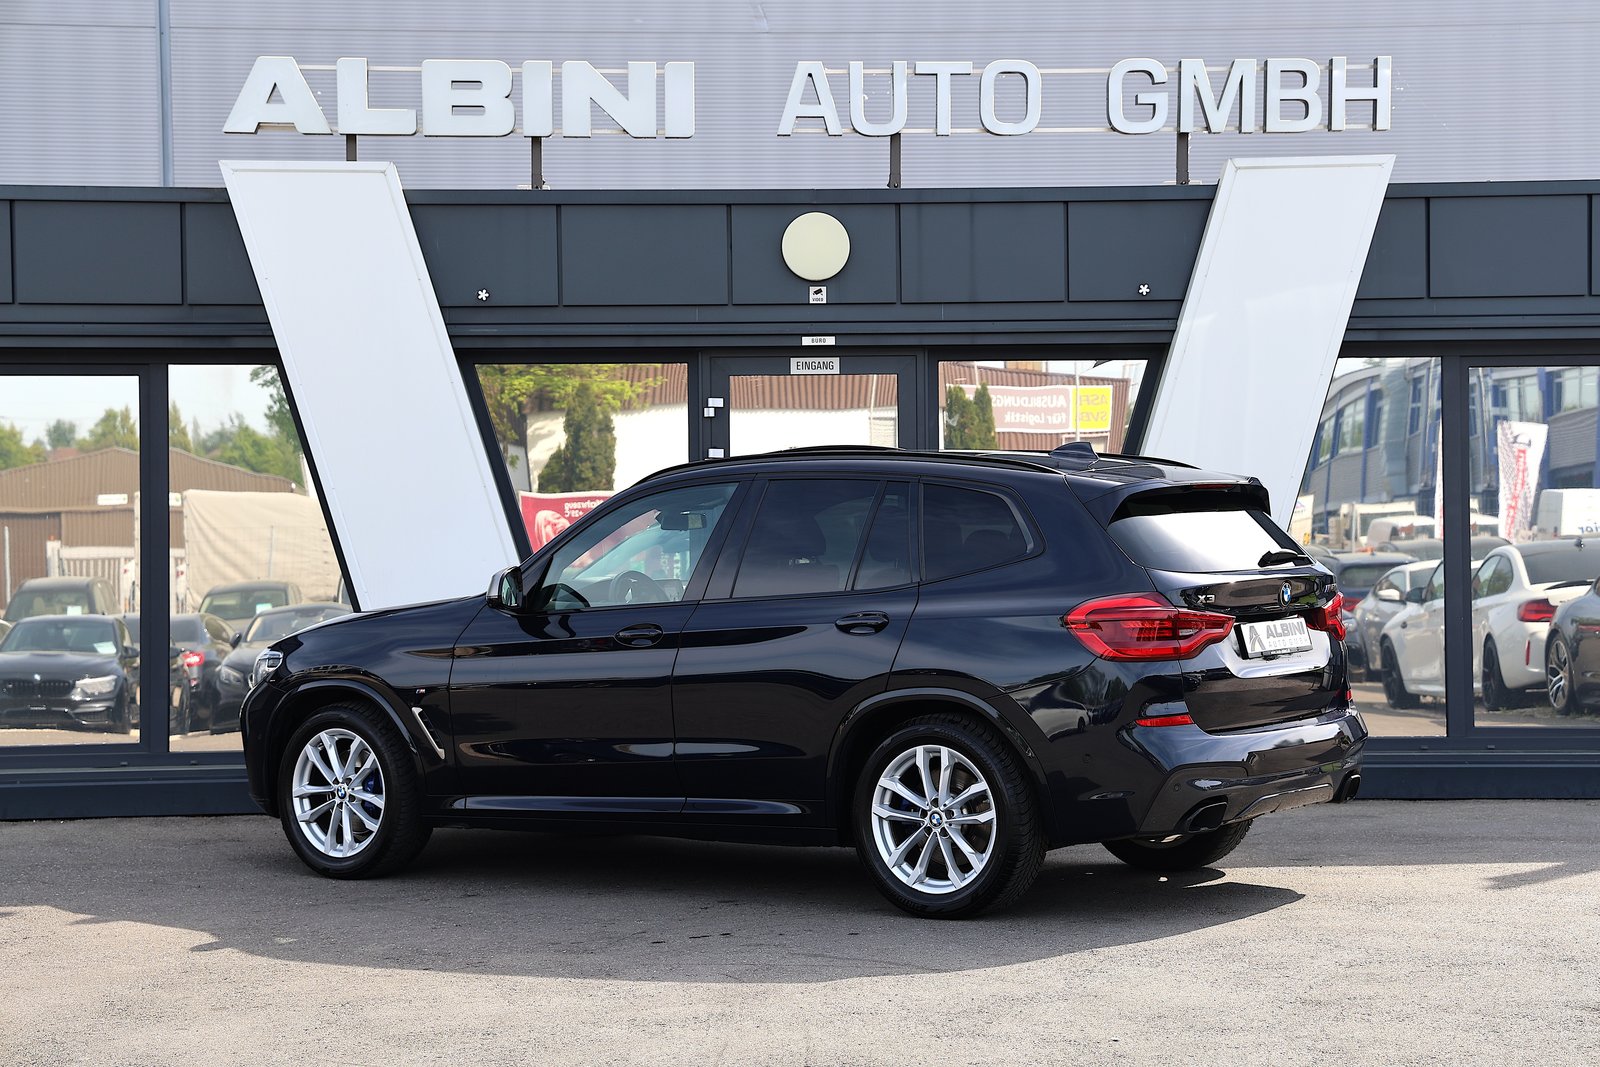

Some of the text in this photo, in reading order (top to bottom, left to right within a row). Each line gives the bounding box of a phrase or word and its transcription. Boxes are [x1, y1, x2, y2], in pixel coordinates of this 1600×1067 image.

[223, 55, 1392, 138] ALBINI AUTO GMBH
[796, 361, 834, 370] EINGANG
[1197, 594, 1215, 603] X3
[1266, 621, 1306, 639] ALBINI
